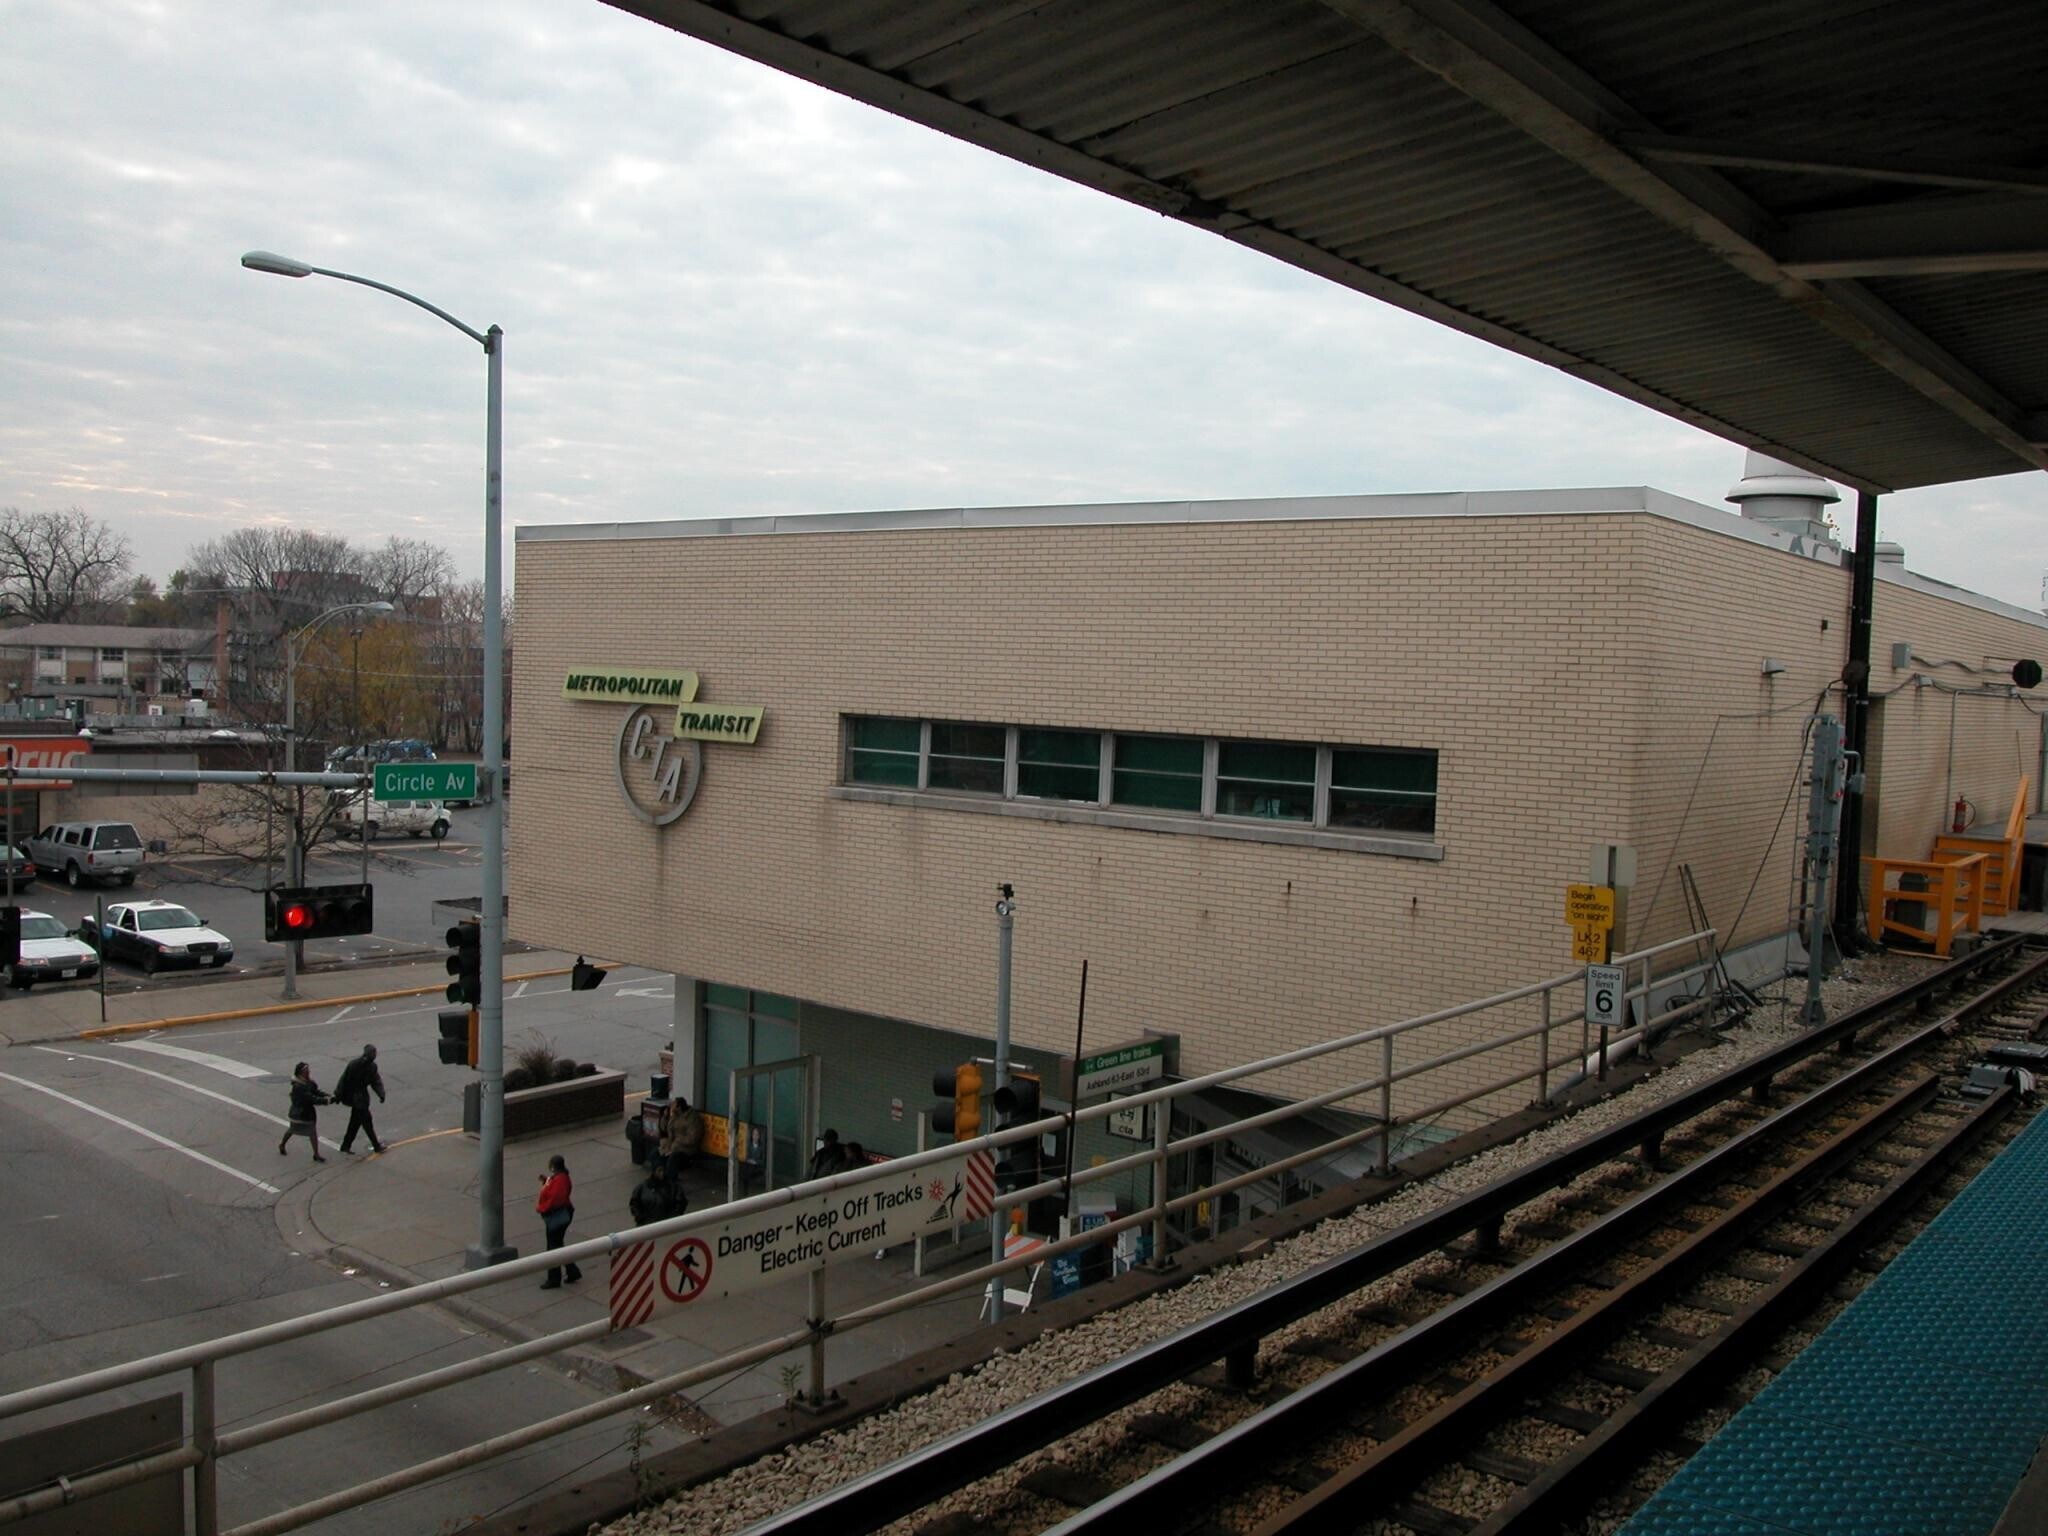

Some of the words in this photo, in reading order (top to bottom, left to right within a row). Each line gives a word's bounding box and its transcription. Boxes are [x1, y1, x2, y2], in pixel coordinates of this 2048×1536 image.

[566, 674, 683, 696] METROPOLITAN
[680, 712, 755, 734] TRANSIT
[630, 715, 685, 803] CTA
[385, 773, 435, 791] Circle
[446, 773, 465, 790] Av
[1571, 890, 1595, 901] Begin
[1571, 902, 1609, 912] operation
[1578, 946, 1599, 957] 467
[1591, 970, 1620, 980] Speed
[1596, 980, 1613, 989] limit
[1596, 990, 1612, 1012] 6
[1097, 1056, 1118, 1068] Green
[1119, 1050, 1131, 1062] line
[843, 1195, 868, 1219] Off
[874, 1185, 923, 1211] Tracks
[761, 1238, 823, 1273] Electric
[828, 1218, 886, 1251] Current
